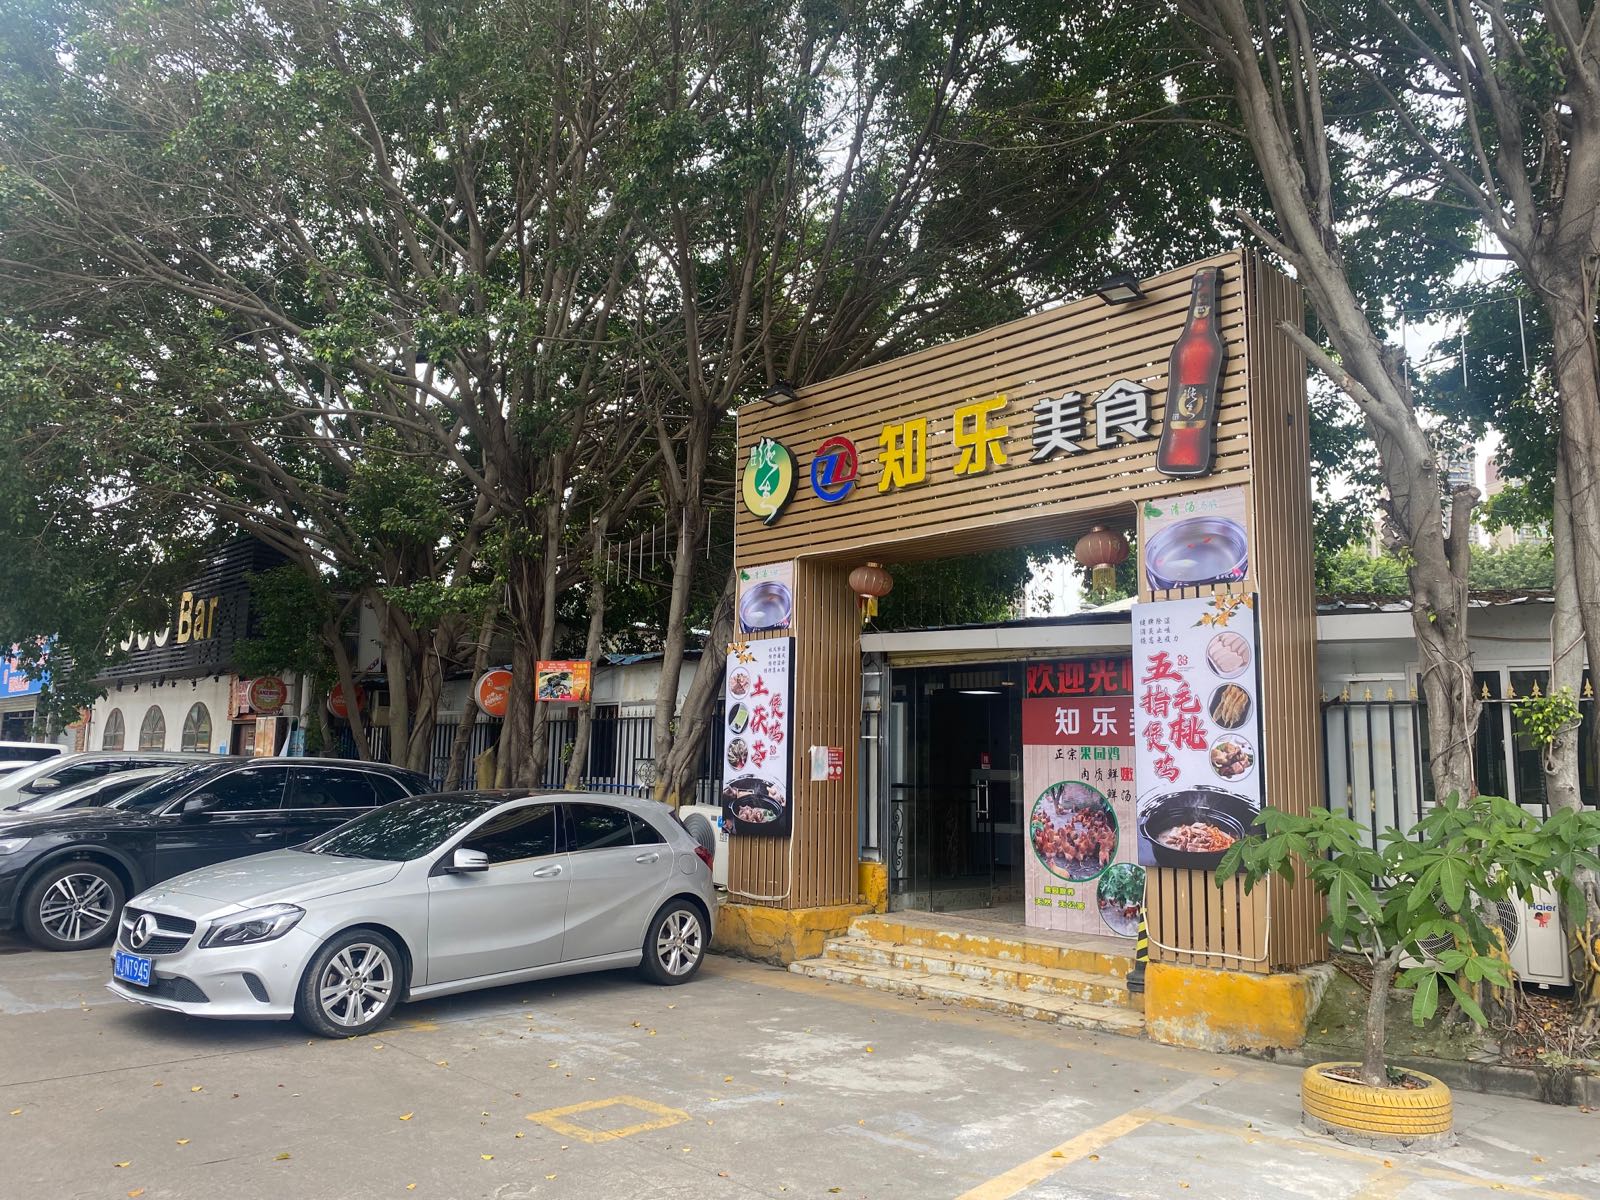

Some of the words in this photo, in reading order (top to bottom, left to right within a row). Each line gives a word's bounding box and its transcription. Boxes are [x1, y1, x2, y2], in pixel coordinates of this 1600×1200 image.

[878, 379, 1151, 492] 知乐美食
[177, 591, 219, 643] Bar
[1055, 706, 1135, 737] 知乐
[1054, 746, 1120, 761] 正宗果园鸡
[1081, 767, 1134, 782] 肉质鲜嫩
[1107, 788, 1137, 802] 鲜汤
[1528, 902, 1557, 912] Haier
